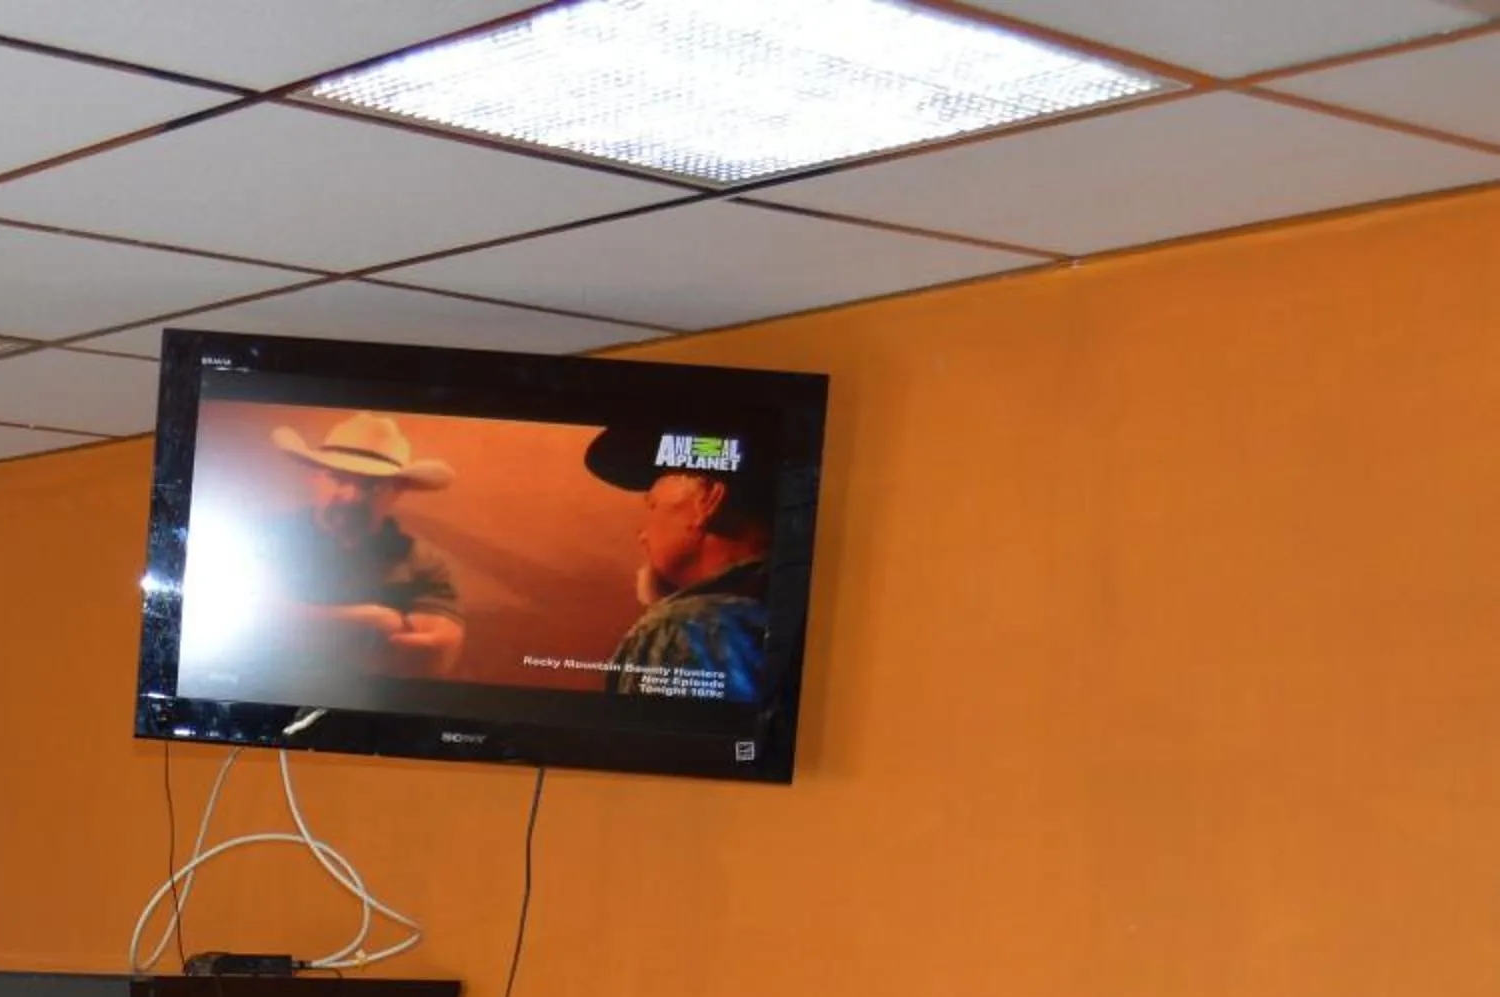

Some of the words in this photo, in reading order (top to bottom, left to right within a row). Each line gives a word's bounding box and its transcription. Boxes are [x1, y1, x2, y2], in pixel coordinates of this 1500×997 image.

[676, 454, 740, 472] PLANET
[523, 655, 561, 669] Rocky
[563, 658, 621, 671] Mountain
[624, 663, 670, 677] Bounty
[673, 667, 726, 679] Hunters
[641, 675, 669, 685] New
[672, 677, 726, 689] Episode
[639, 683, 687, 697] Tonight
[441, 732, 487, 744] SONY
